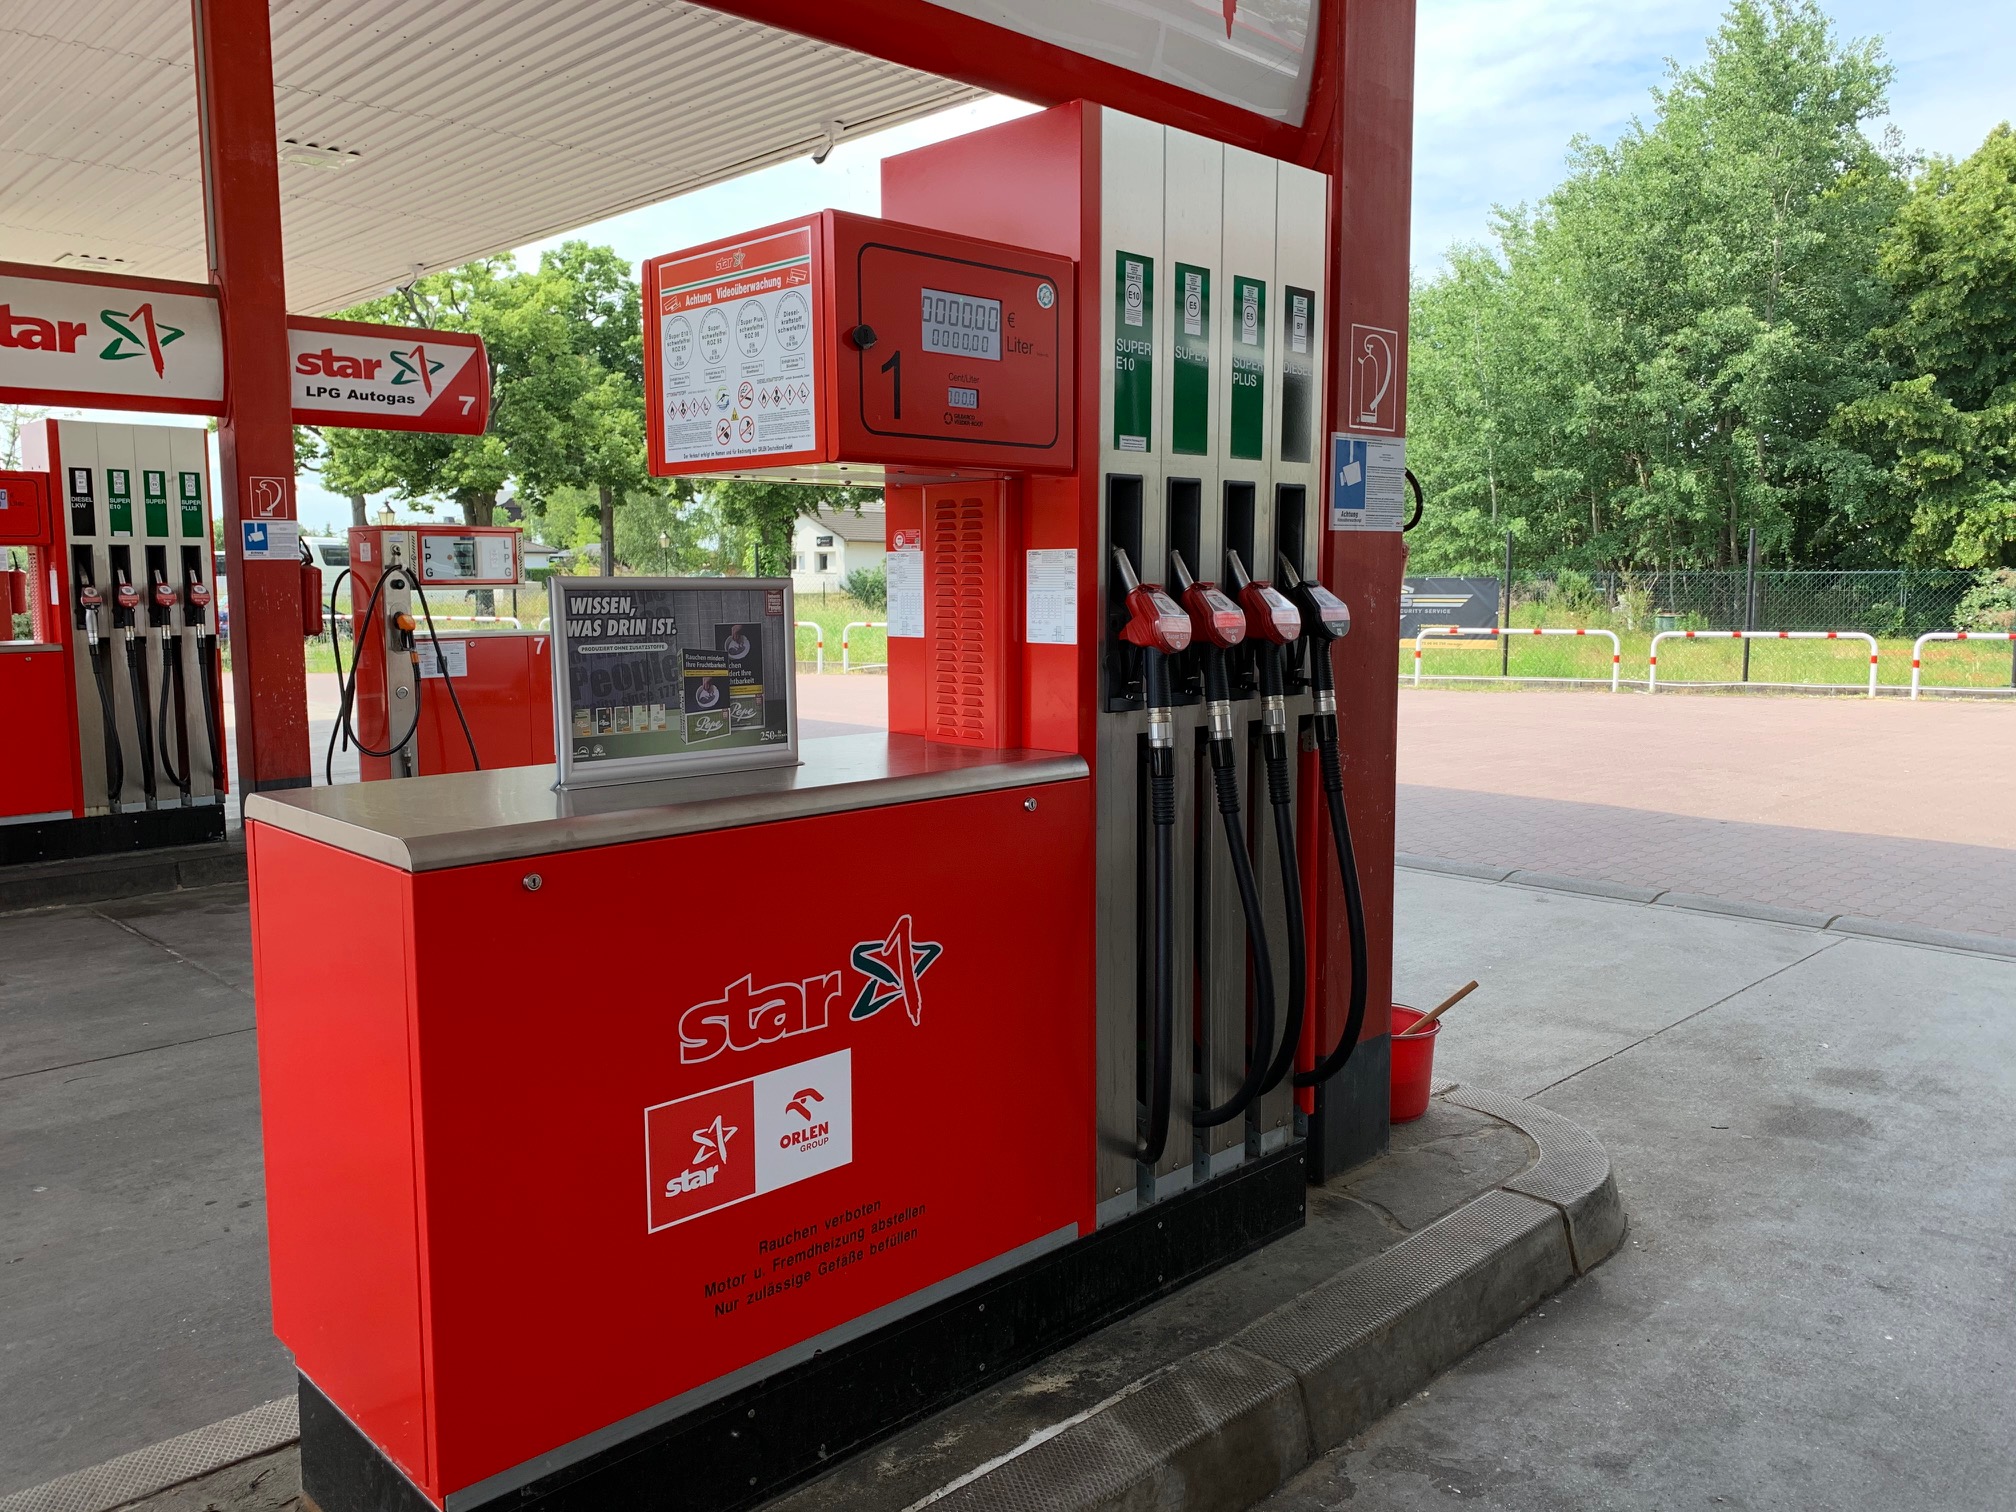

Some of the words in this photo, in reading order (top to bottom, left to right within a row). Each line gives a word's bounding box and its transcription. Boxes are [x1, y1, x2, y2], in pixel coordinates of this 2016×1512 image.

[685, 292, 712, 307] Achtung
[716, 276, 781, 299] Videoüberwachung
[1128, 290, 1140, 301] E10
[1189, 301, 1197, 310] E5
[1007, 312, 1016, 328] €
[1246, 312, 1253, 321] E5
[0, 303, 87, 353] tar
[931, 329, 989, 352] 0000,00
[1007, 336, 1033, 354] Liter
[1116, 338, 1151, 355] SUPER
[1116, 356, 1135, 371] E10
[1174, 346, 1208, 363] SUPER
[296, 348, 382, 380] star
[1233, 356, 1263, 372] SUPER
[1283, 361, 1312, 377] DIESEL
[881, 350, 902, 420] 1
[948, 372, 979, 384] Cent/Liter
[1232, 372, 1257, 387] PLUS
[305, 386, 341, 399] LPG
[347, 389, 415, 406] Autogas
[458, 396, 476, 416] 7
[570, 597, 637, 616] WISSEN,
[567, 619, 602, 637] WAS
[607, 618, 646, 636] DRIN
[651, 618, 677, 635] IST.
[533, 637, 545, 655] 7
[629, 643, 665, 651] ZUSATZSTOFFE
[685, 653, 706, 661] Rauchen
[730, 702, 757, 722] Pepe
[695, 716, 723, 735] Pepe
[760, 730, 775, 741] 250
[678, 970, 842, 1064] star
[779, 1121, 829, 1149] ORLEN
[800, 1137, 829, 1152] GROUP
[665, 1165, 719, 1197] star
[759, 1223, 817, 1255] Rauchen
[825, 1200, 881, 1230] verboten
[704, 1273, 747, 1298] Motor
[754, 1265, 765, 1279] u.
[772, 1225, 865, 1272] Fremdheizung
[871, 1202, 926, 1234] abstellen
[714, 1297, 739, 1318] Nur
[746, 1270, 811, 1305] zulässige
[818, 1248, 864, 1276] Gefäße
[870, 1227, 918, 1255] befüllen
